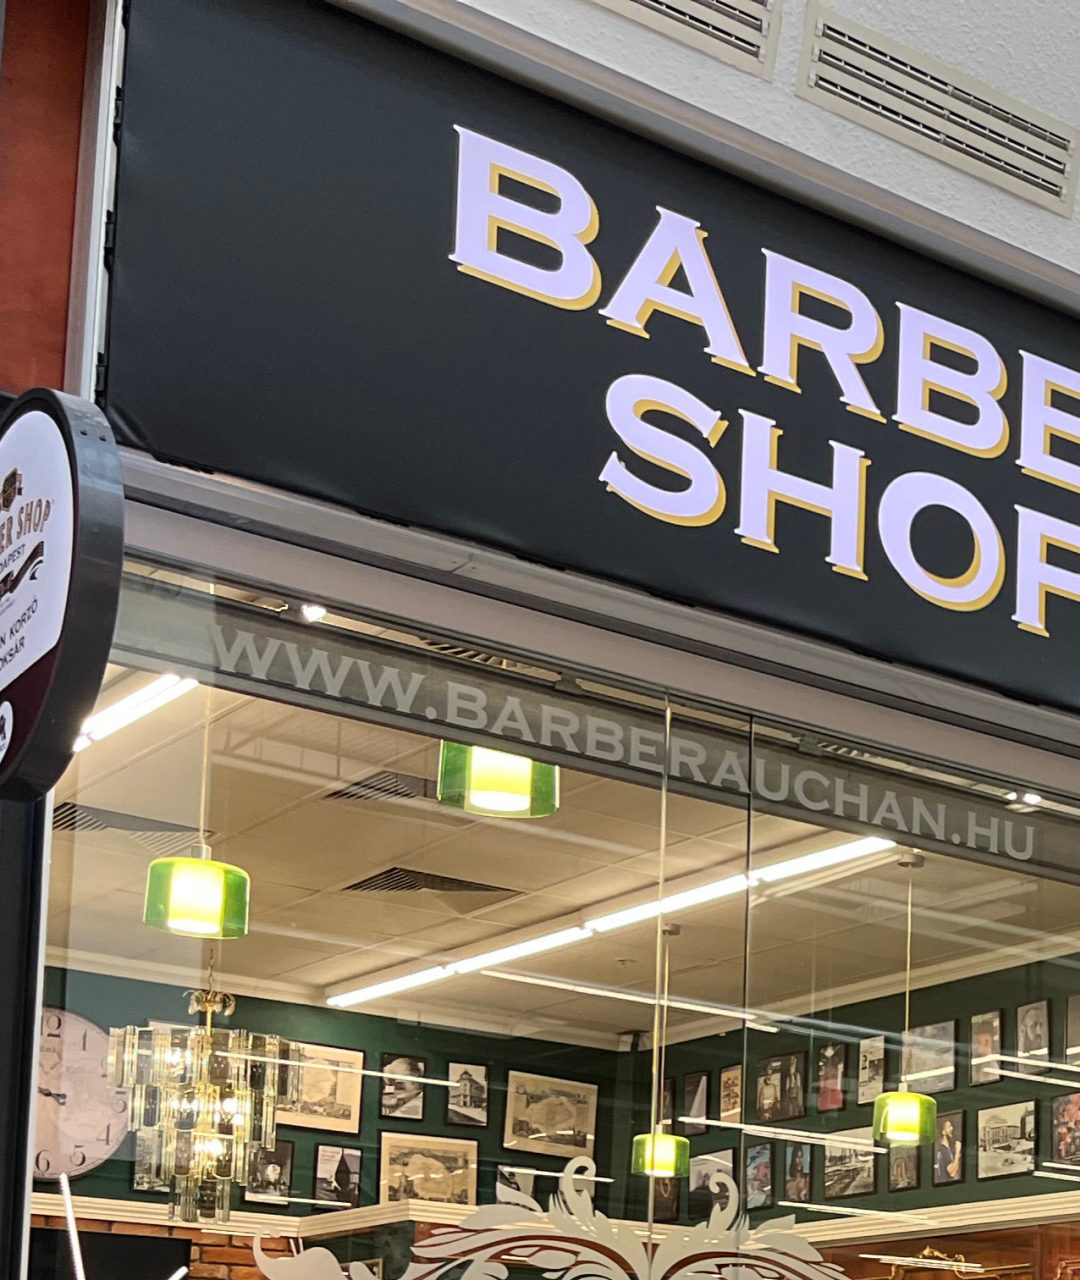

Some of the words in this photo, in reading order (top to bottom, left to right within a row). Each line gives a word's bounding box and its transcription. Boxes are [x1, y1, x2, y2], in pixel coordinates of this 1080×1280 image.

[17, 498, 52, 540] SHOP
[0, 544, 25, 571] DAPEST
[207, 619, 1036, 861] WWW.BARBERAUCHAN.HU
